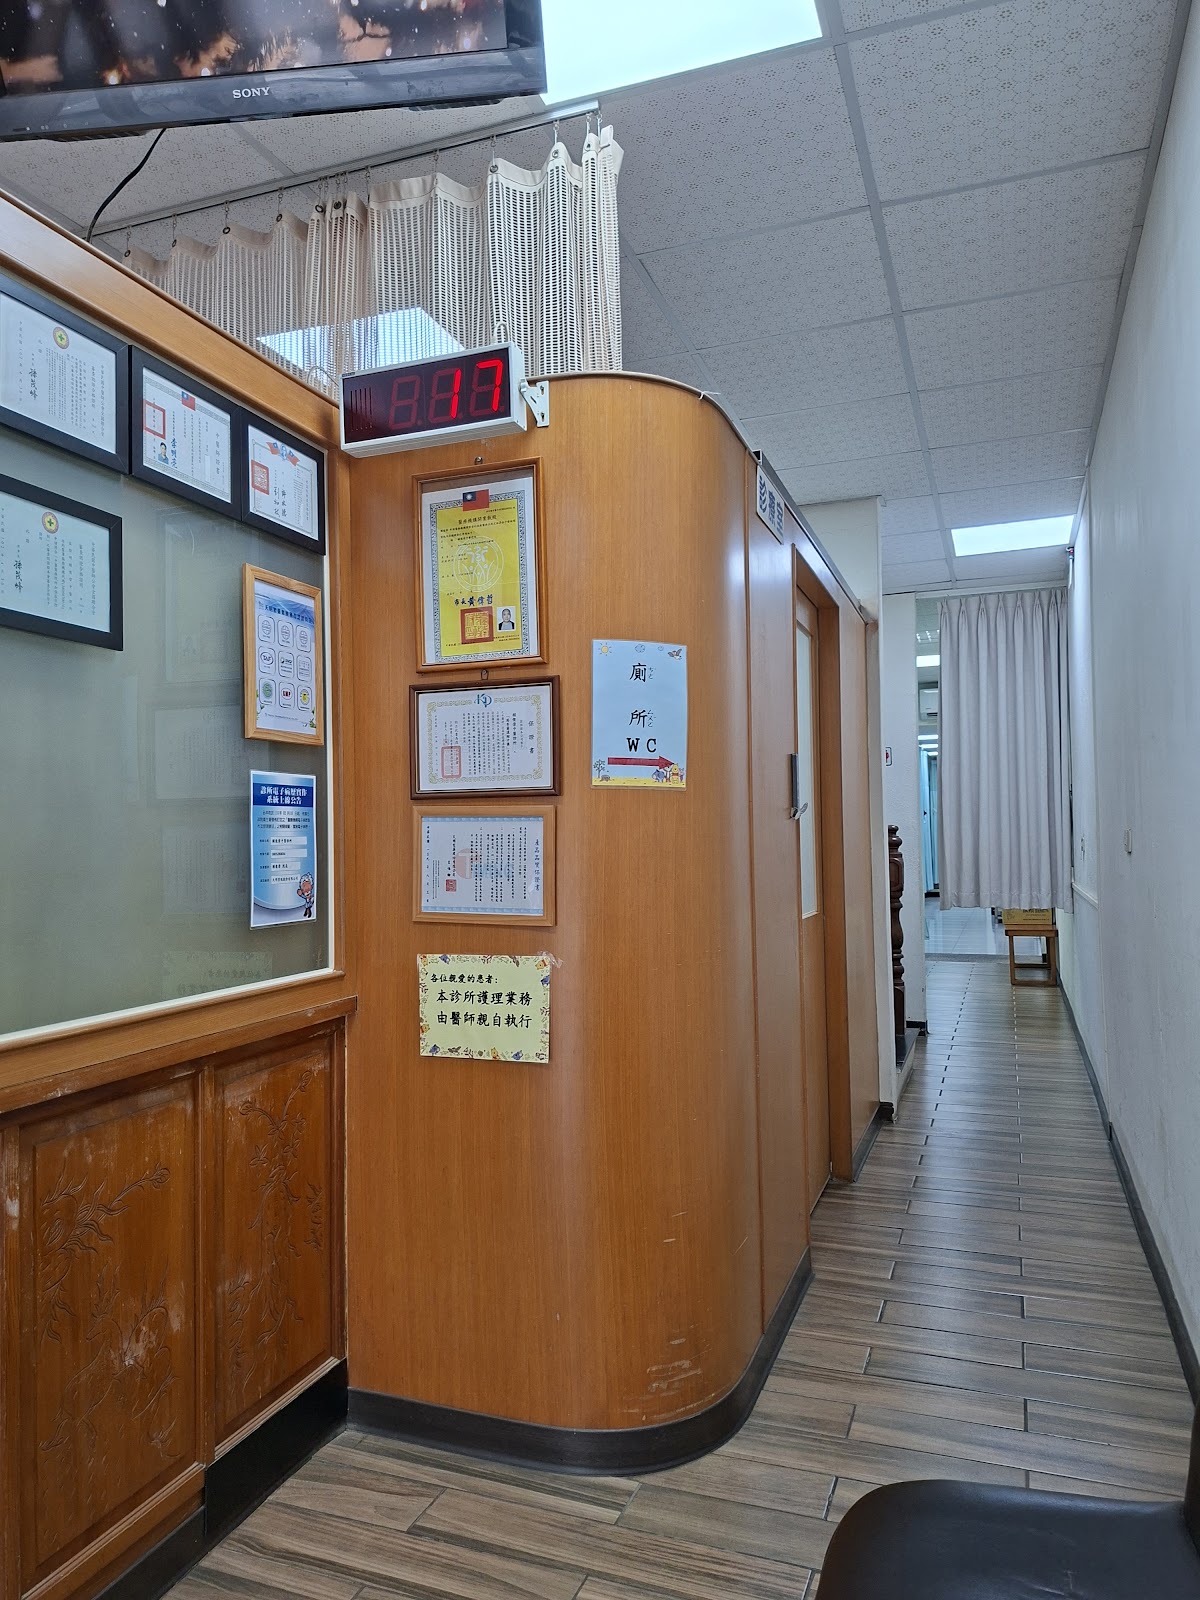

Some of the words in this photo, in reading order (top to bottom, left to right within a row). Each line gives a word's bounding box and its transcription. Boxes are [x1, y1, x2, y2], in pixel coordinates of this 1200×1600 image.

[232, 86, 271, 100] SONY
[450, 358, 504, 419] 17
[430, 973, 499, 985] 各位親愛的患者:
[436, 989, 534, 1007] 本診所護理業務
[436, 1010, 533, 1029] 由醫師親自執行
